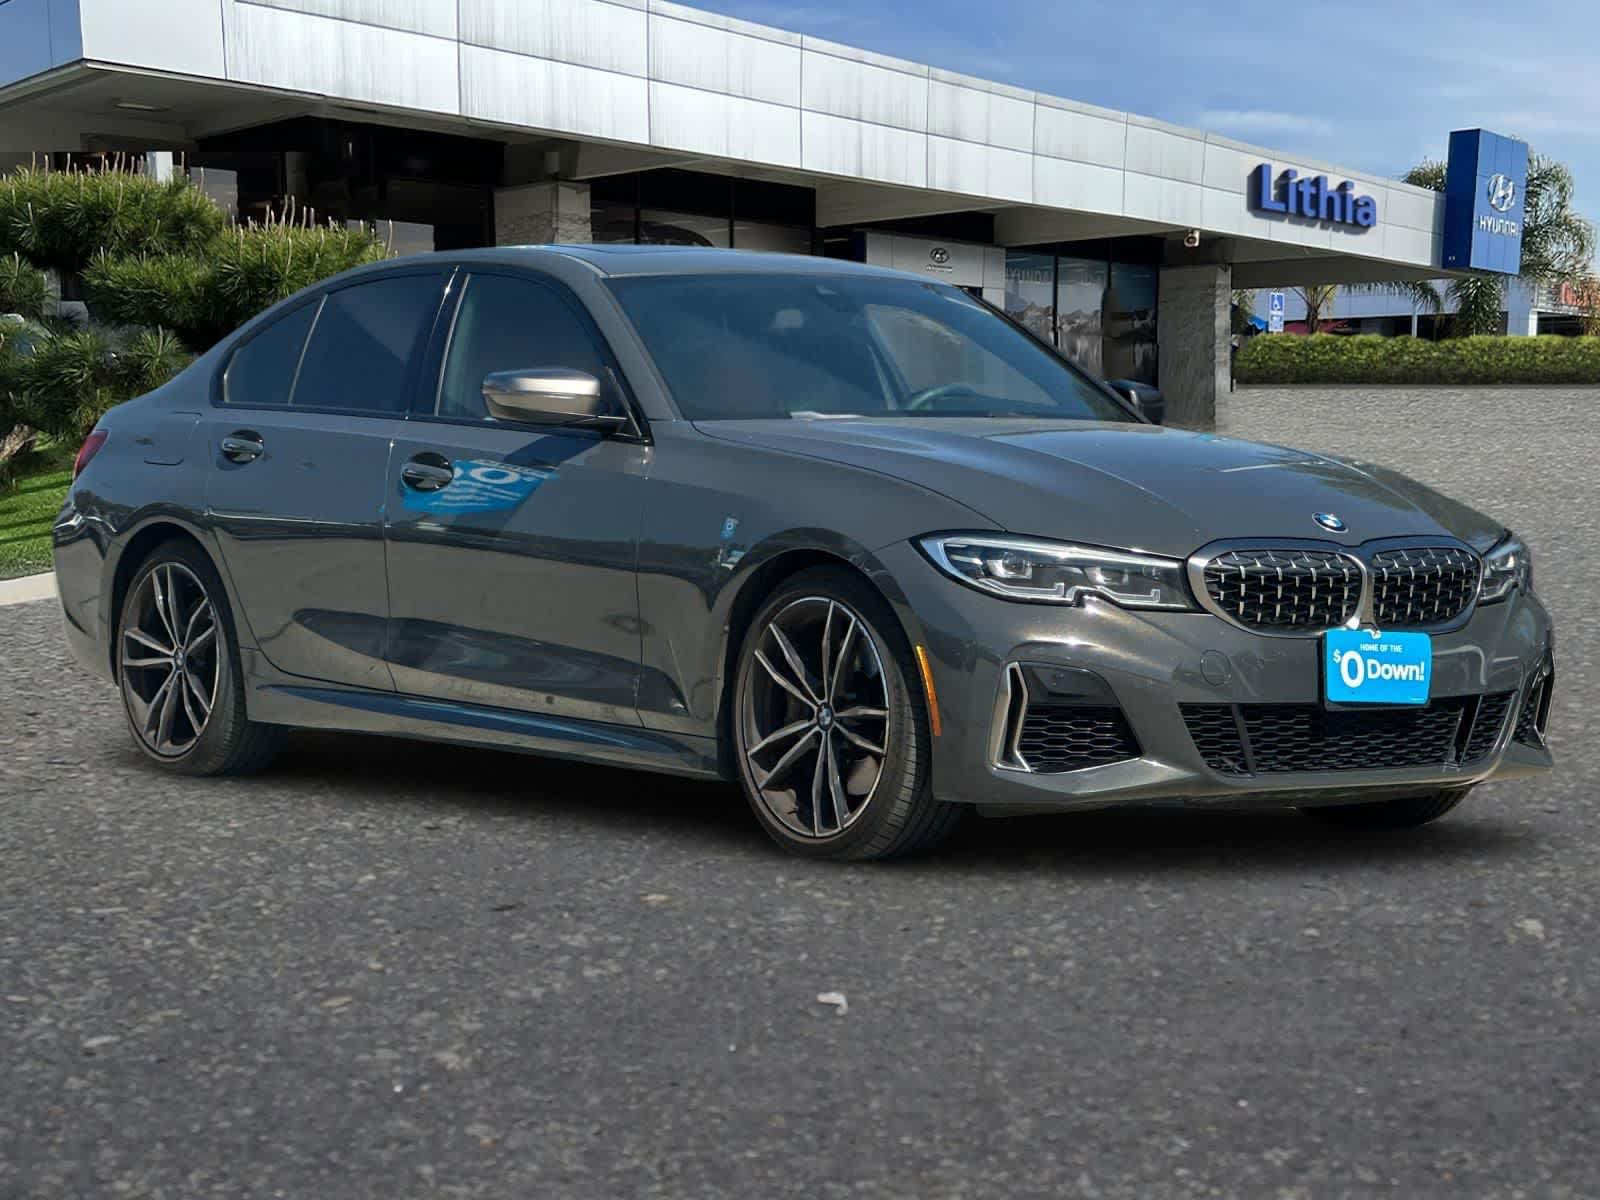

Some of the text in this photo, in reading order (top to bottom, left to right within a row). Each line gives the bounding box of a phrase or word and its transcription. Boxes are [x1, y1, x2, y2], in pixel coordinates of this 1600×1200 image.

[1254, 163, 1376, 228] Lithia
[1360, 643, 1403, 653] HOME OF THE
[1367, 658, 1425, 681] Down!
